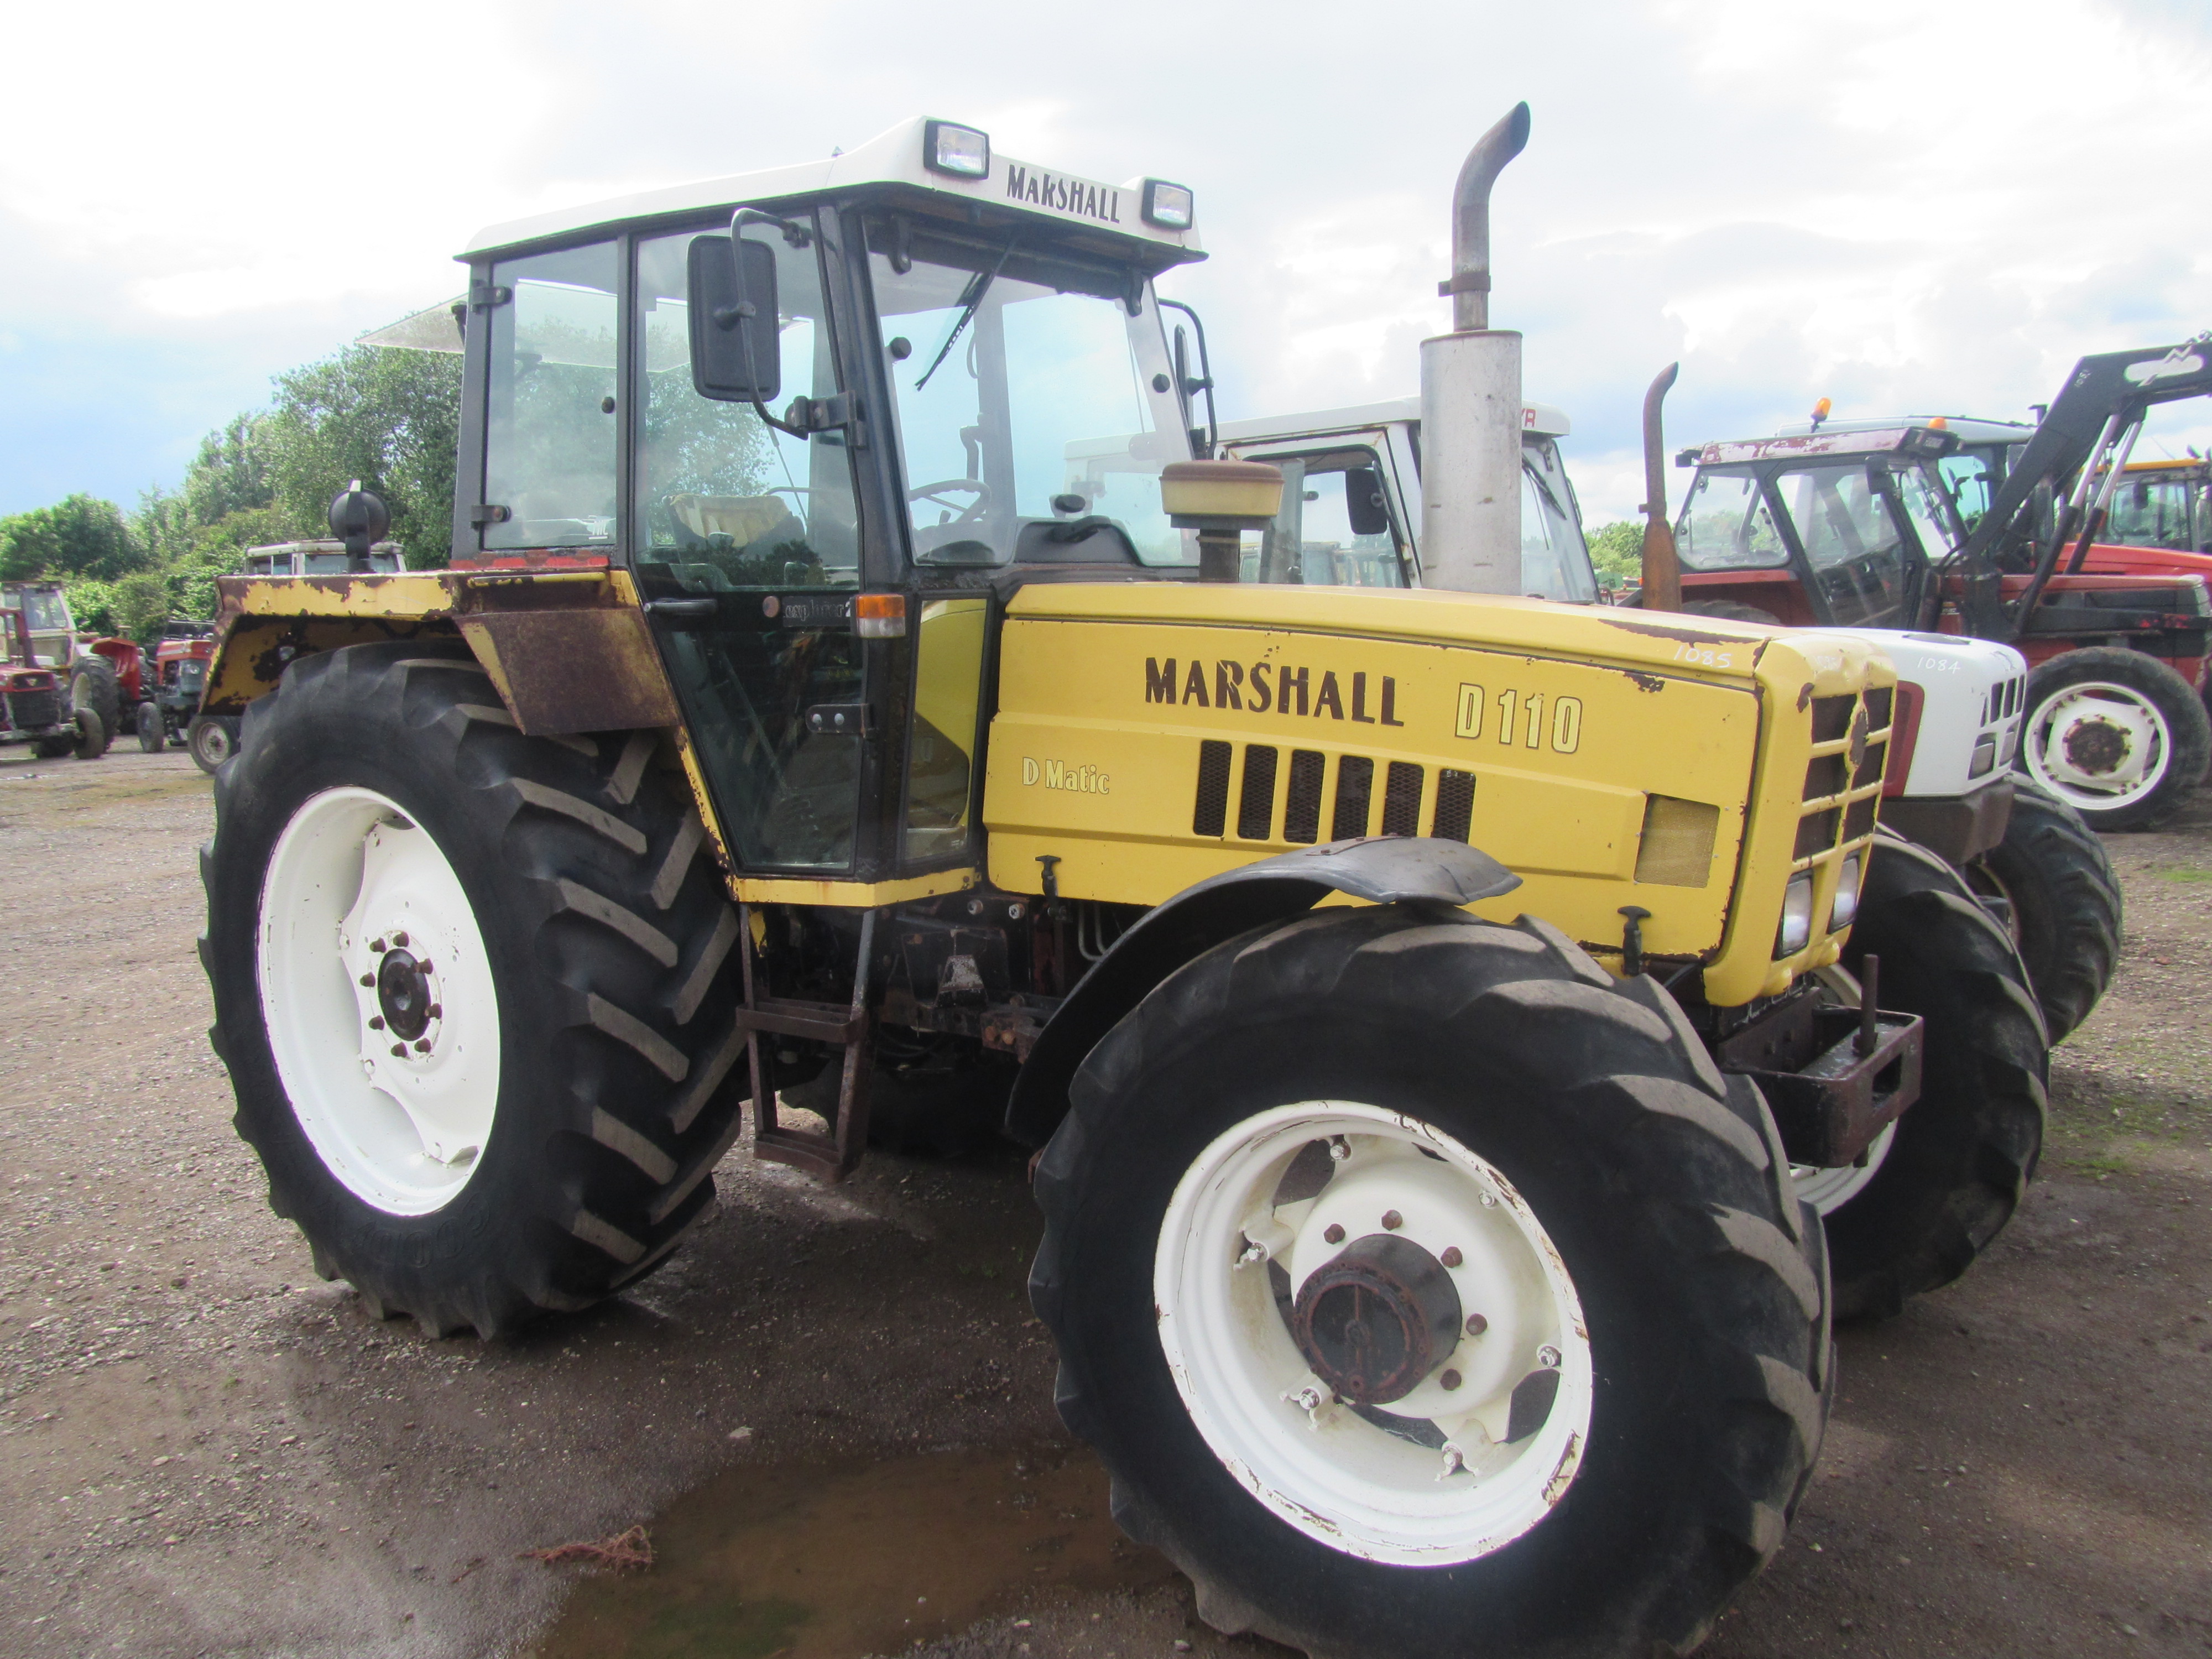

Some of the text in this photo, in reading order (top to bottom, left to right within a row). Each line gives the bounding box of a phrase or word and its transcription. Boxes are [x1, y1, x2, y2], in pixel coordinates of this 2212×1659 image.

[1006, 164, 1120, 224] MARSHALL
[1673, 644, 1733, 668] 1085
[1917, 656, 1961, 674] 1084
[1145, 657, 1404, 727] MARSHALL
[1045, 759, 1110, 795] Matic
